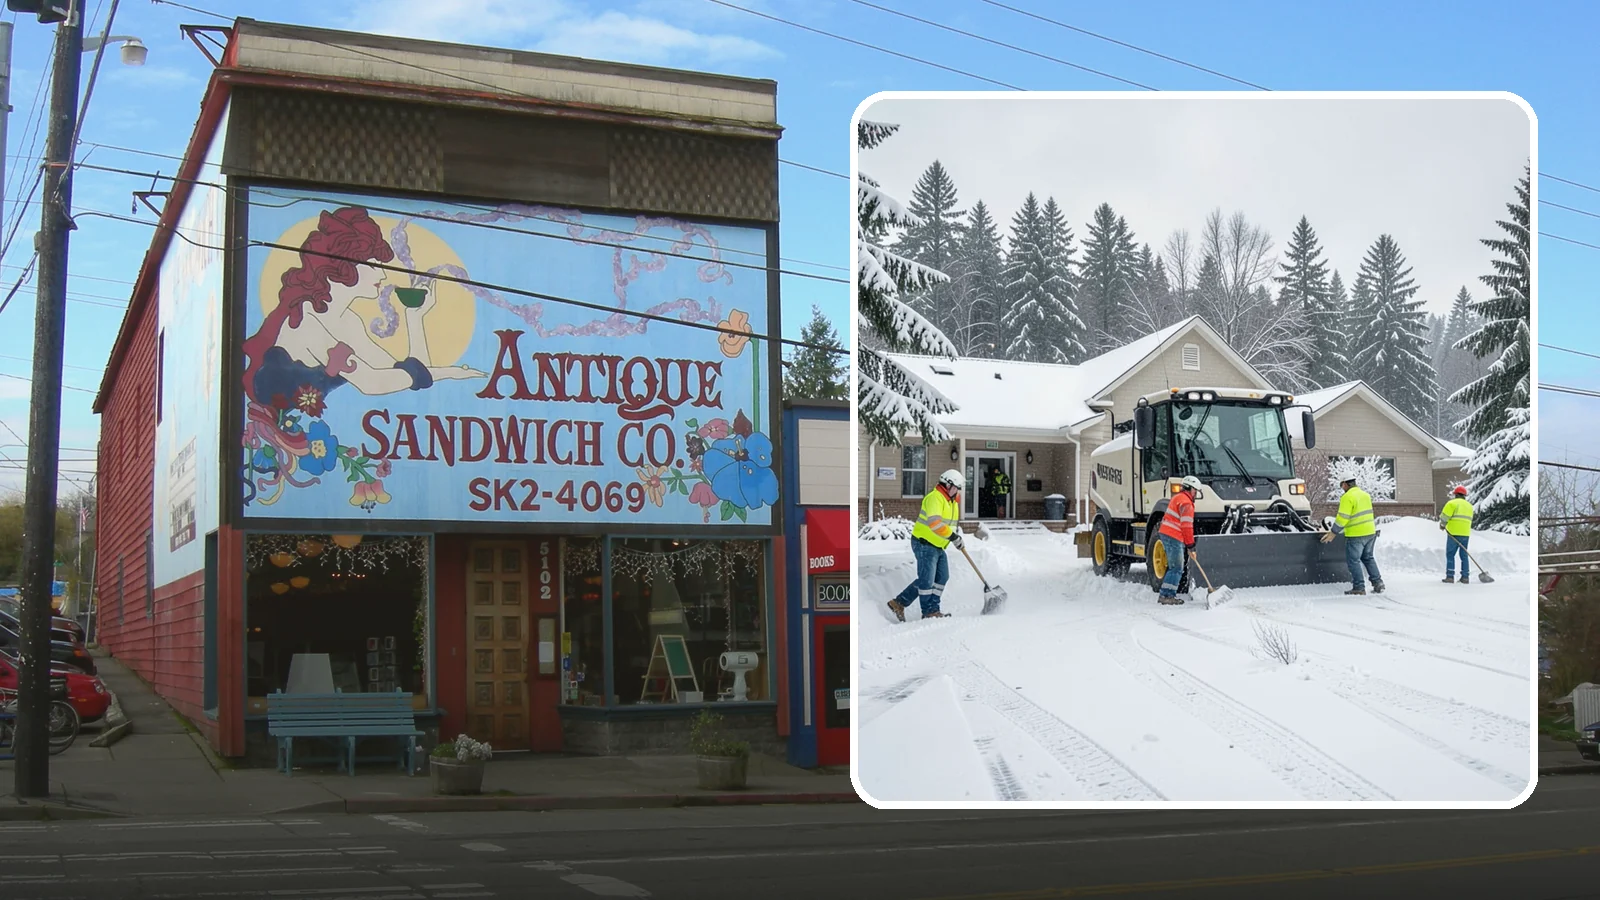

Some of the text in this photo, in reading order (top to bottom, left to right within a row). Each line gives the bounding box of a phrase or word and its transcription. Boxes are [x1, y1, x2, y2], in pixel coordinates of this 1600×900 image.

[475, 328, 723, 421] ANTIQUE
[361, 408, 685, 468] SANDWICH CO.
[467, 477, 646, 513] SK2-4069
[540, 541, 552, 600] 5102
[809, 555, 835, 569] BOOKS
